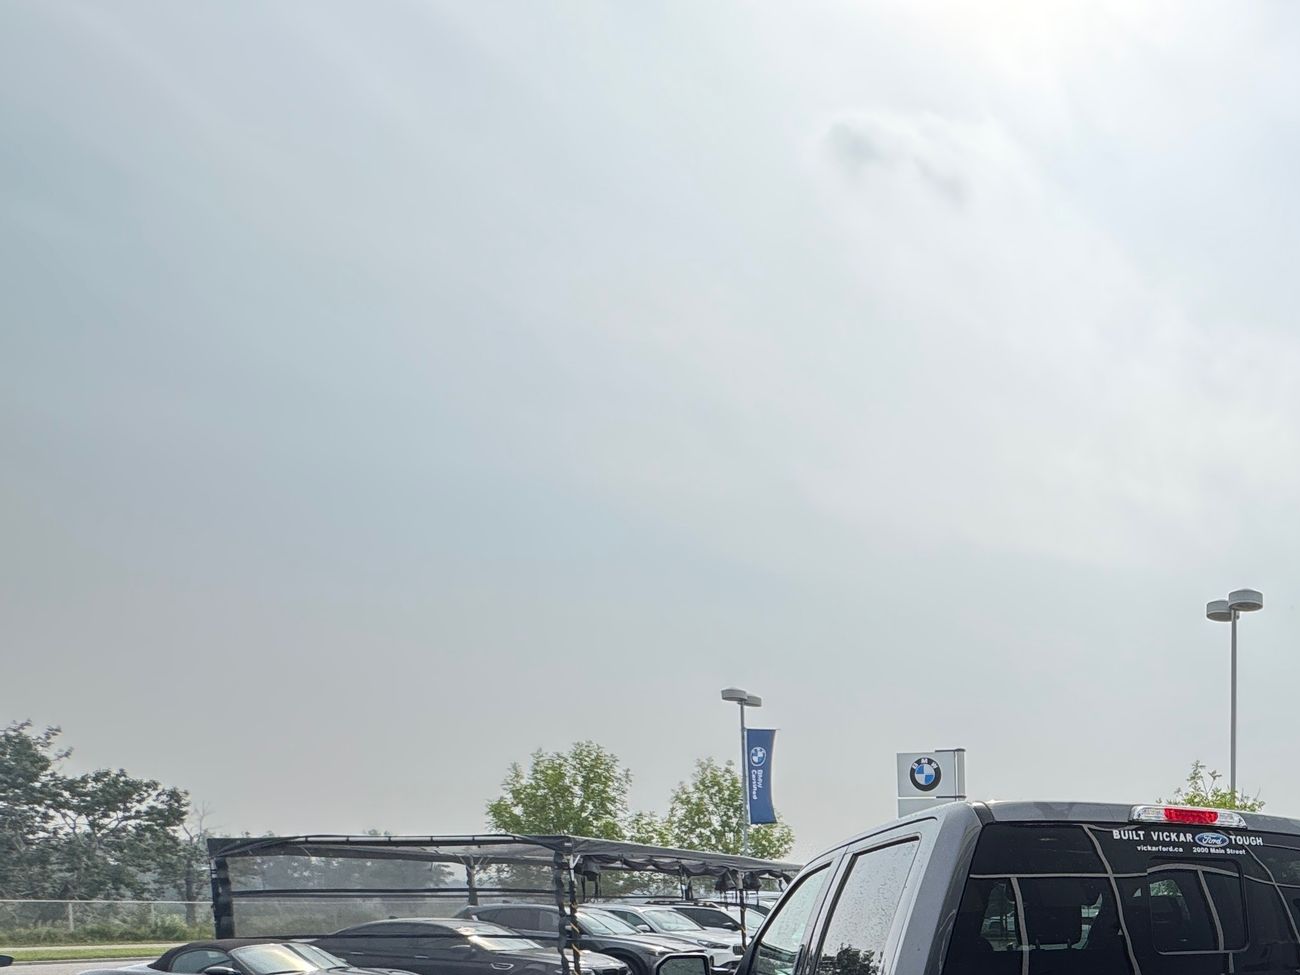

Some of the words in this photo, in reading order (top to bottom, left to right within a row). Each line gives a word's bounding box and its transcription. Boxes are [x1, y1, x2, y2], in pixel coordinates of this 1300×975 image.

[911, 758, 938, 770] BMW
[1112, 829, 1145, 841] BUILT
[1151, 831, 1194, 843] VICKAR
[1230, 836, 1263, 847] TOUGH
[1136, 845, 1184, 853] vickarford.ca
